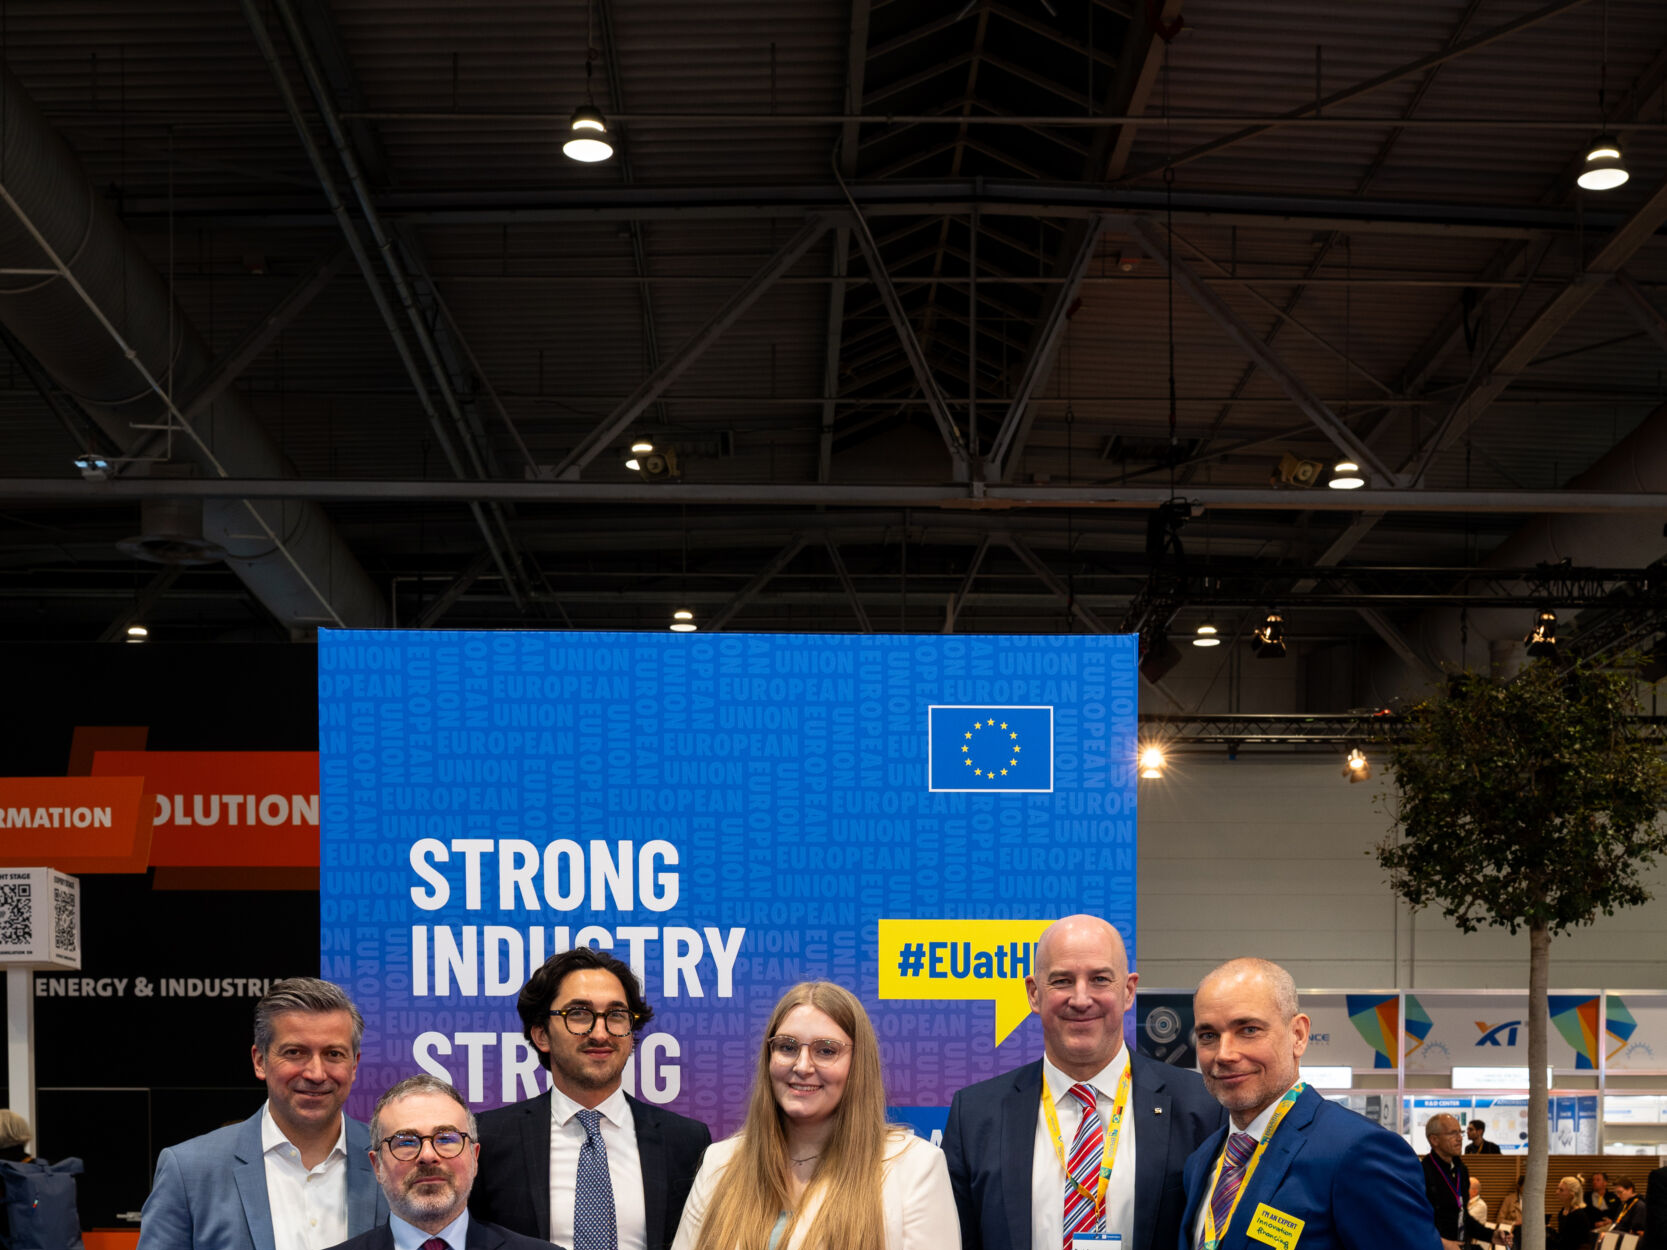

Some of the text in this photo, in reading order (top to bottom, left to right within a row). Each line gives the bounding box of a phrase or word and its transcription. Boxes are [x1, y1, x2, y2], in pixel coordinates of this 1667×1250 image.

[322, 646, 400, 668] UNION
[550, 649, 628, 671] UNION
[775, 651, 853, 673] UNION
[999, 653, 1077, 674] UNION
[320, 674, 401, 697] OPEAN
[438, 648, 459, 726] UNION
[465, 632, 488, 727] OPEAN
[494, 676, 628, 698] EUROPEAN
[664, 650, 686, 728] UNION
[691, 633, 715, 729] OPEAN
[720, 678, 854, 700] EUROPEAN
[889, 652, 910, 730] UNION
[944, 680, 1078, 702] EUROPEAN
[1111, 654, 1133, 732] UNION
[409, 647, 432, 782] EUROPEAN
[494, 705, 572, 727] UNION
[636, 649, 658, 784] EUROPEAN
[720, 707, 798, 729] UNION
[860, 651, 883, 786] EUROPEAN
[1083, 653, 1106, 788] EUROPEAN
[382, 704, 403, 782] UNION
[438, 732, 572, 754] EUROPEAN
[608, 706, 630, 784] UNION
[664, 734, 798, 756] EUROPEAN
[833, 708, 854, 786] UNION
[1056, 709, 1077, 788] UNION
[353, 703, 376, 838] EUROPEAN
[438, 761, 516, 782] UNION
[580, 705, 603, 840] EUROPEAN
[664, 762, 742, 784] UNION
[805, 707, 827, 842] EUROPEAN
[888, 764, 928, 787] UNI
[326, 760, 347, 838] UNION
[382, 787, 516, 810] EUROPEAN
[553, 762, 574, 840] UNION
[608, 789, 742, 812] EUROPEAN
[778, 764, 799, 842] UNION
[832, 791, 966, 813] EUROPEAN
[1054, 792, 1136, 815] EUROP
[383, 816, 461, 838] UNION
[608, 818, 686, 840] UNION
[1000, 793, 1022, 844] ION
[749, 763, 772, 898] EUROPEAN
[832, 820, 910, 842] UNION
[1054, 821, 1132, 843] UNION
[327, 843, 410, 866] EUROP
[722, 819, 743, 897] UNION
[777, 846, 911, 869] EUROPEAN
[972, 795, 996, 900] ROPEAN
[999, 847, 1133, 870] EUROPEAN
[915, 820, 939, 918] EUROPE
[945, 820, 966, 899] UNION
[327, 872, 405, 894] UNION
[409, 838, 680, 912] STRONG
[777, 875, 855, 897] UNION
[998, 876, 1076, 898] UNION
[321, 898, 405, 921] OPEAN
[721, 902, 855, 924] EUROPEAN
[386, 928, 407, 1006] UNION
[898, 941, 1038, 979] #EUatH
[36, 977, 286, 997] ENERGY & INDUSTRI
[412, 1031, 681, 1103] STRG
[722, 1041, 744, 1119] UNION
[1277, 1217, 1298, 1229] EXPERT
